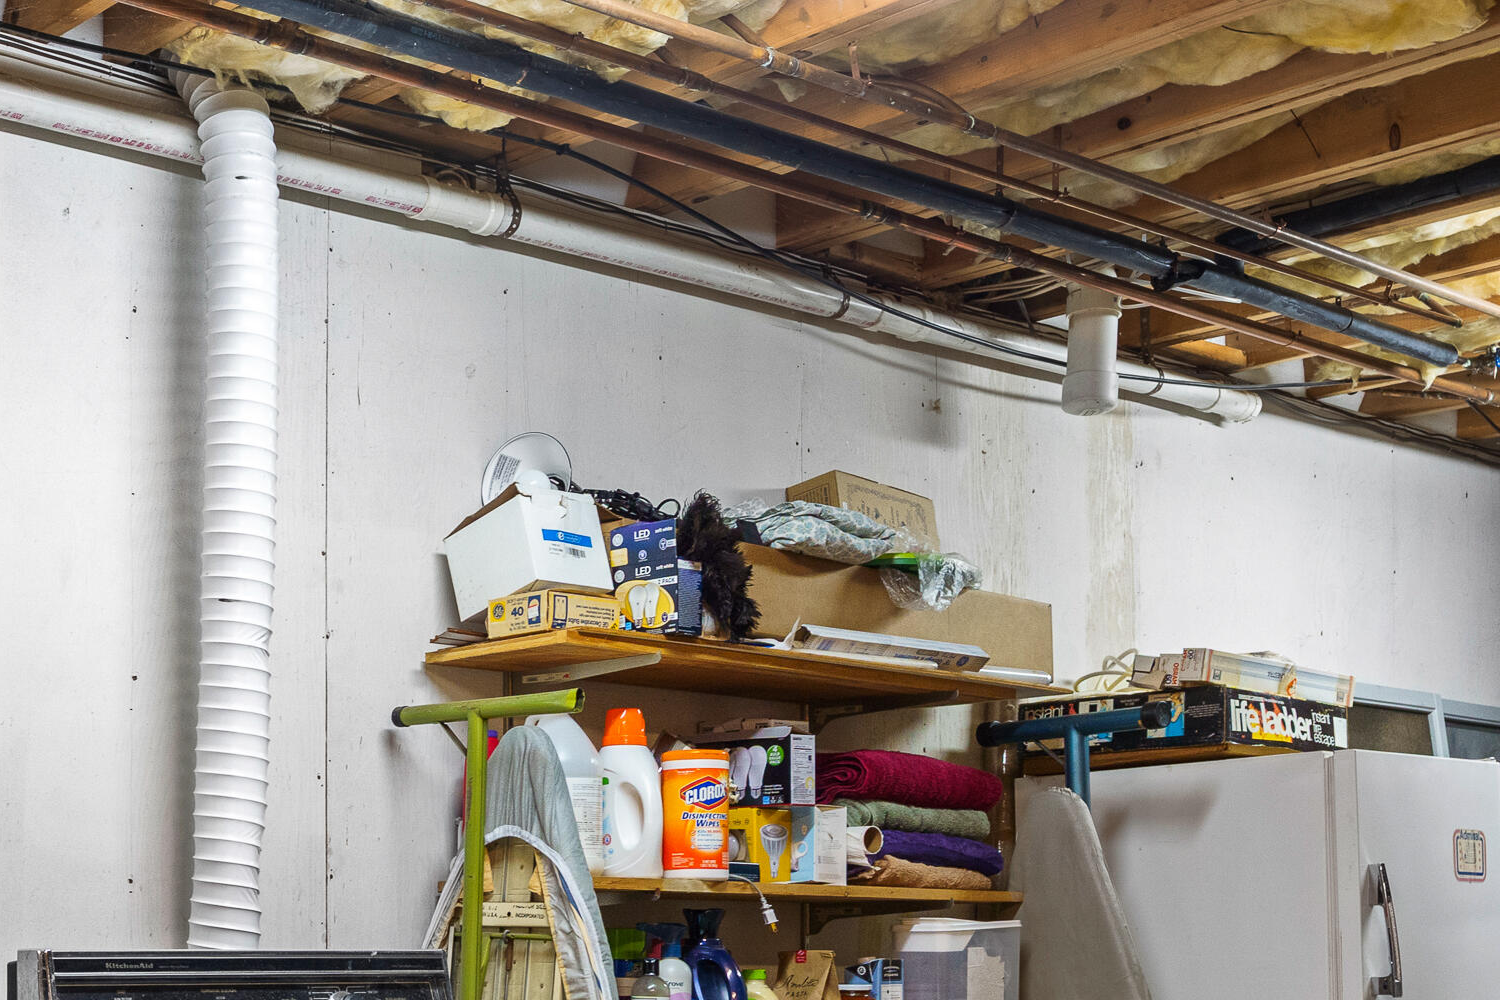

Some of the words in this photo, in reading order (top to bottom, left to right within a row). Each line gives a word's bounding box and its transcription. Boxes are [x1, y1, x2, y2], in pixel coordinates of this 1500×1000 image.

[633, 528, 651, 541] LED
[635, 566, 652, 577] LED
[510, 606, 525, 617] 40
[1172, 662, 1180, 685] OSRAM
[1229, 698, 1260, 734] life
[1259, 701, 1313, 742] ladder
[1313, 732, 1336, 748] escape
[685, 783, 727, 805] CLOROX
[696, 819, 720, 828] WIPES
[105, 961, 154, 970] KitchenAid
